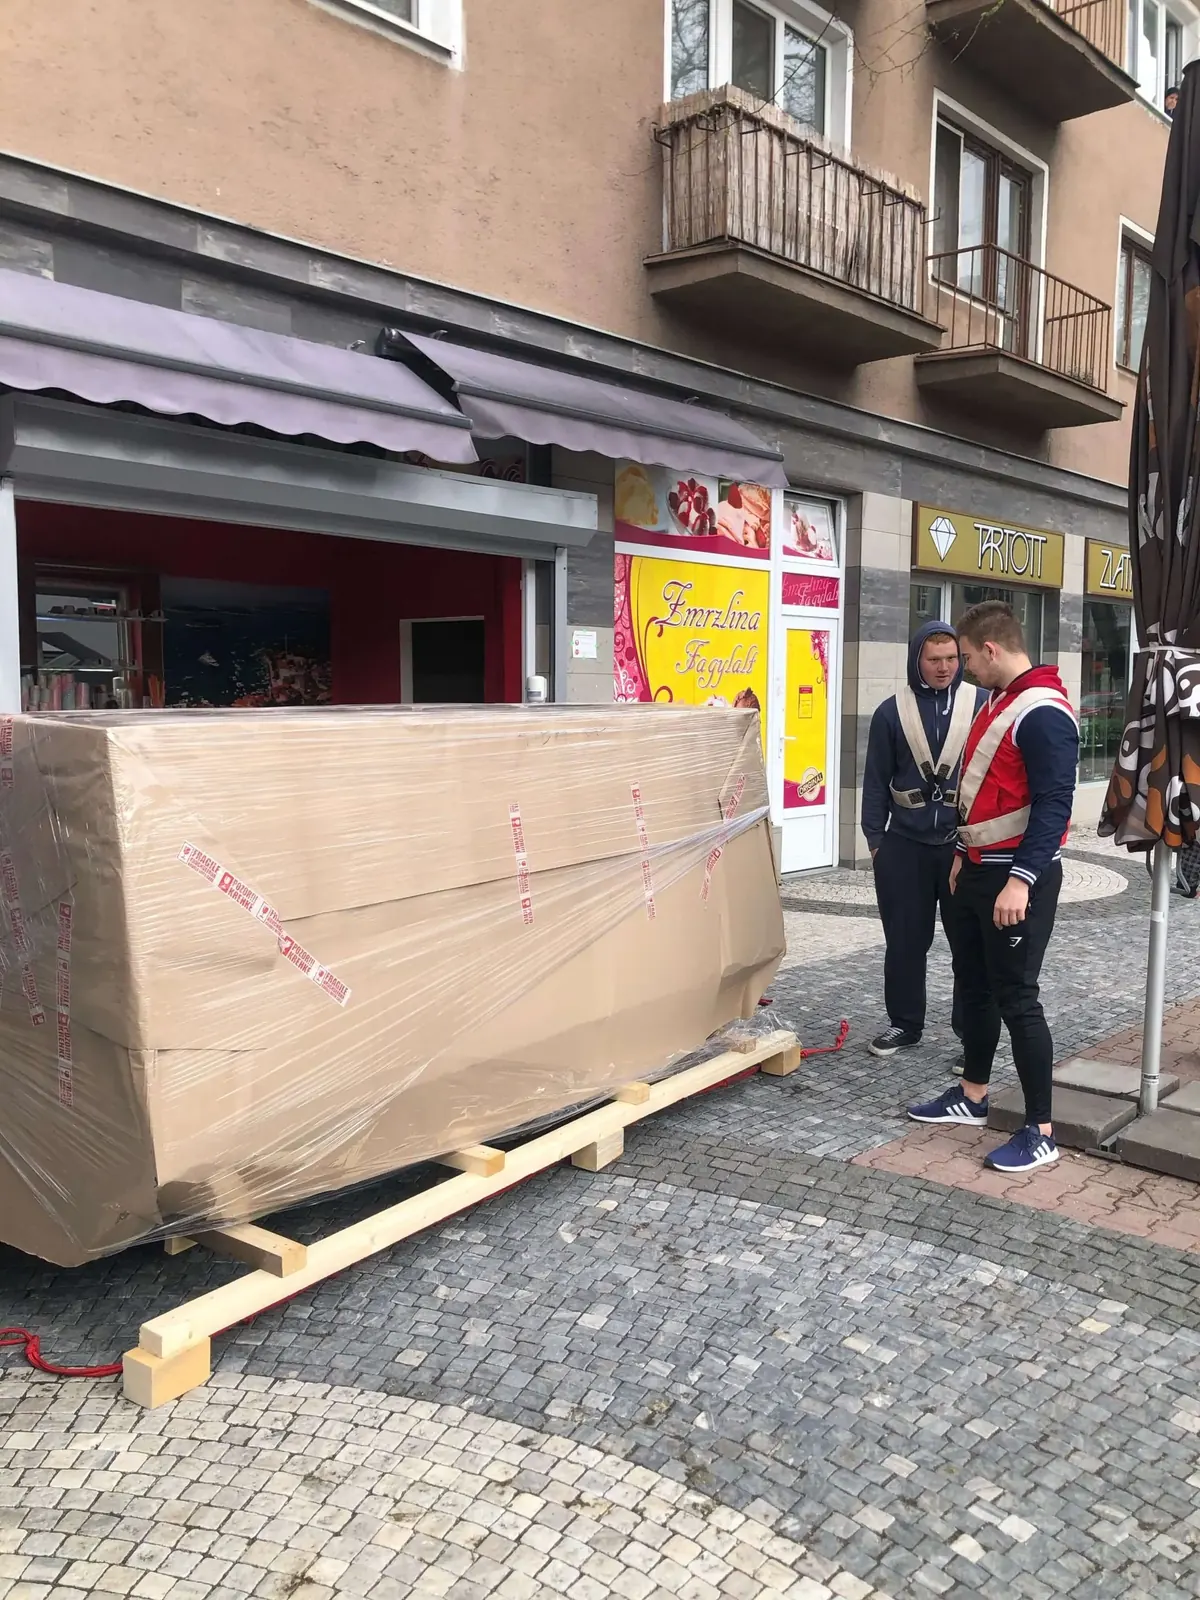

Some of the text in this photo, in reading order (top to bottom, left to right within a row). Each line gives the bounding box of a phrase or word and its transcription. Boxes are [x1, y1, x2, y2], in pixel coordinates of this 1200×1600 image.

[655, 580, 761, 631] Zmrzlina
[675, 639, 759, 689] Fagylalt
[799, 772, 823, 796] ORIGINAL
[192, 848, 221, 873] FRAGILE
[227, 886, 255, 912] KREHKE
[233, 878, 259, 903] POZOR!!!
[287, 951, 312, 975] KREHKE
[291, 943, 316, 968] POZOR!!!
[325, 972, 349, 995] FRAGILE
